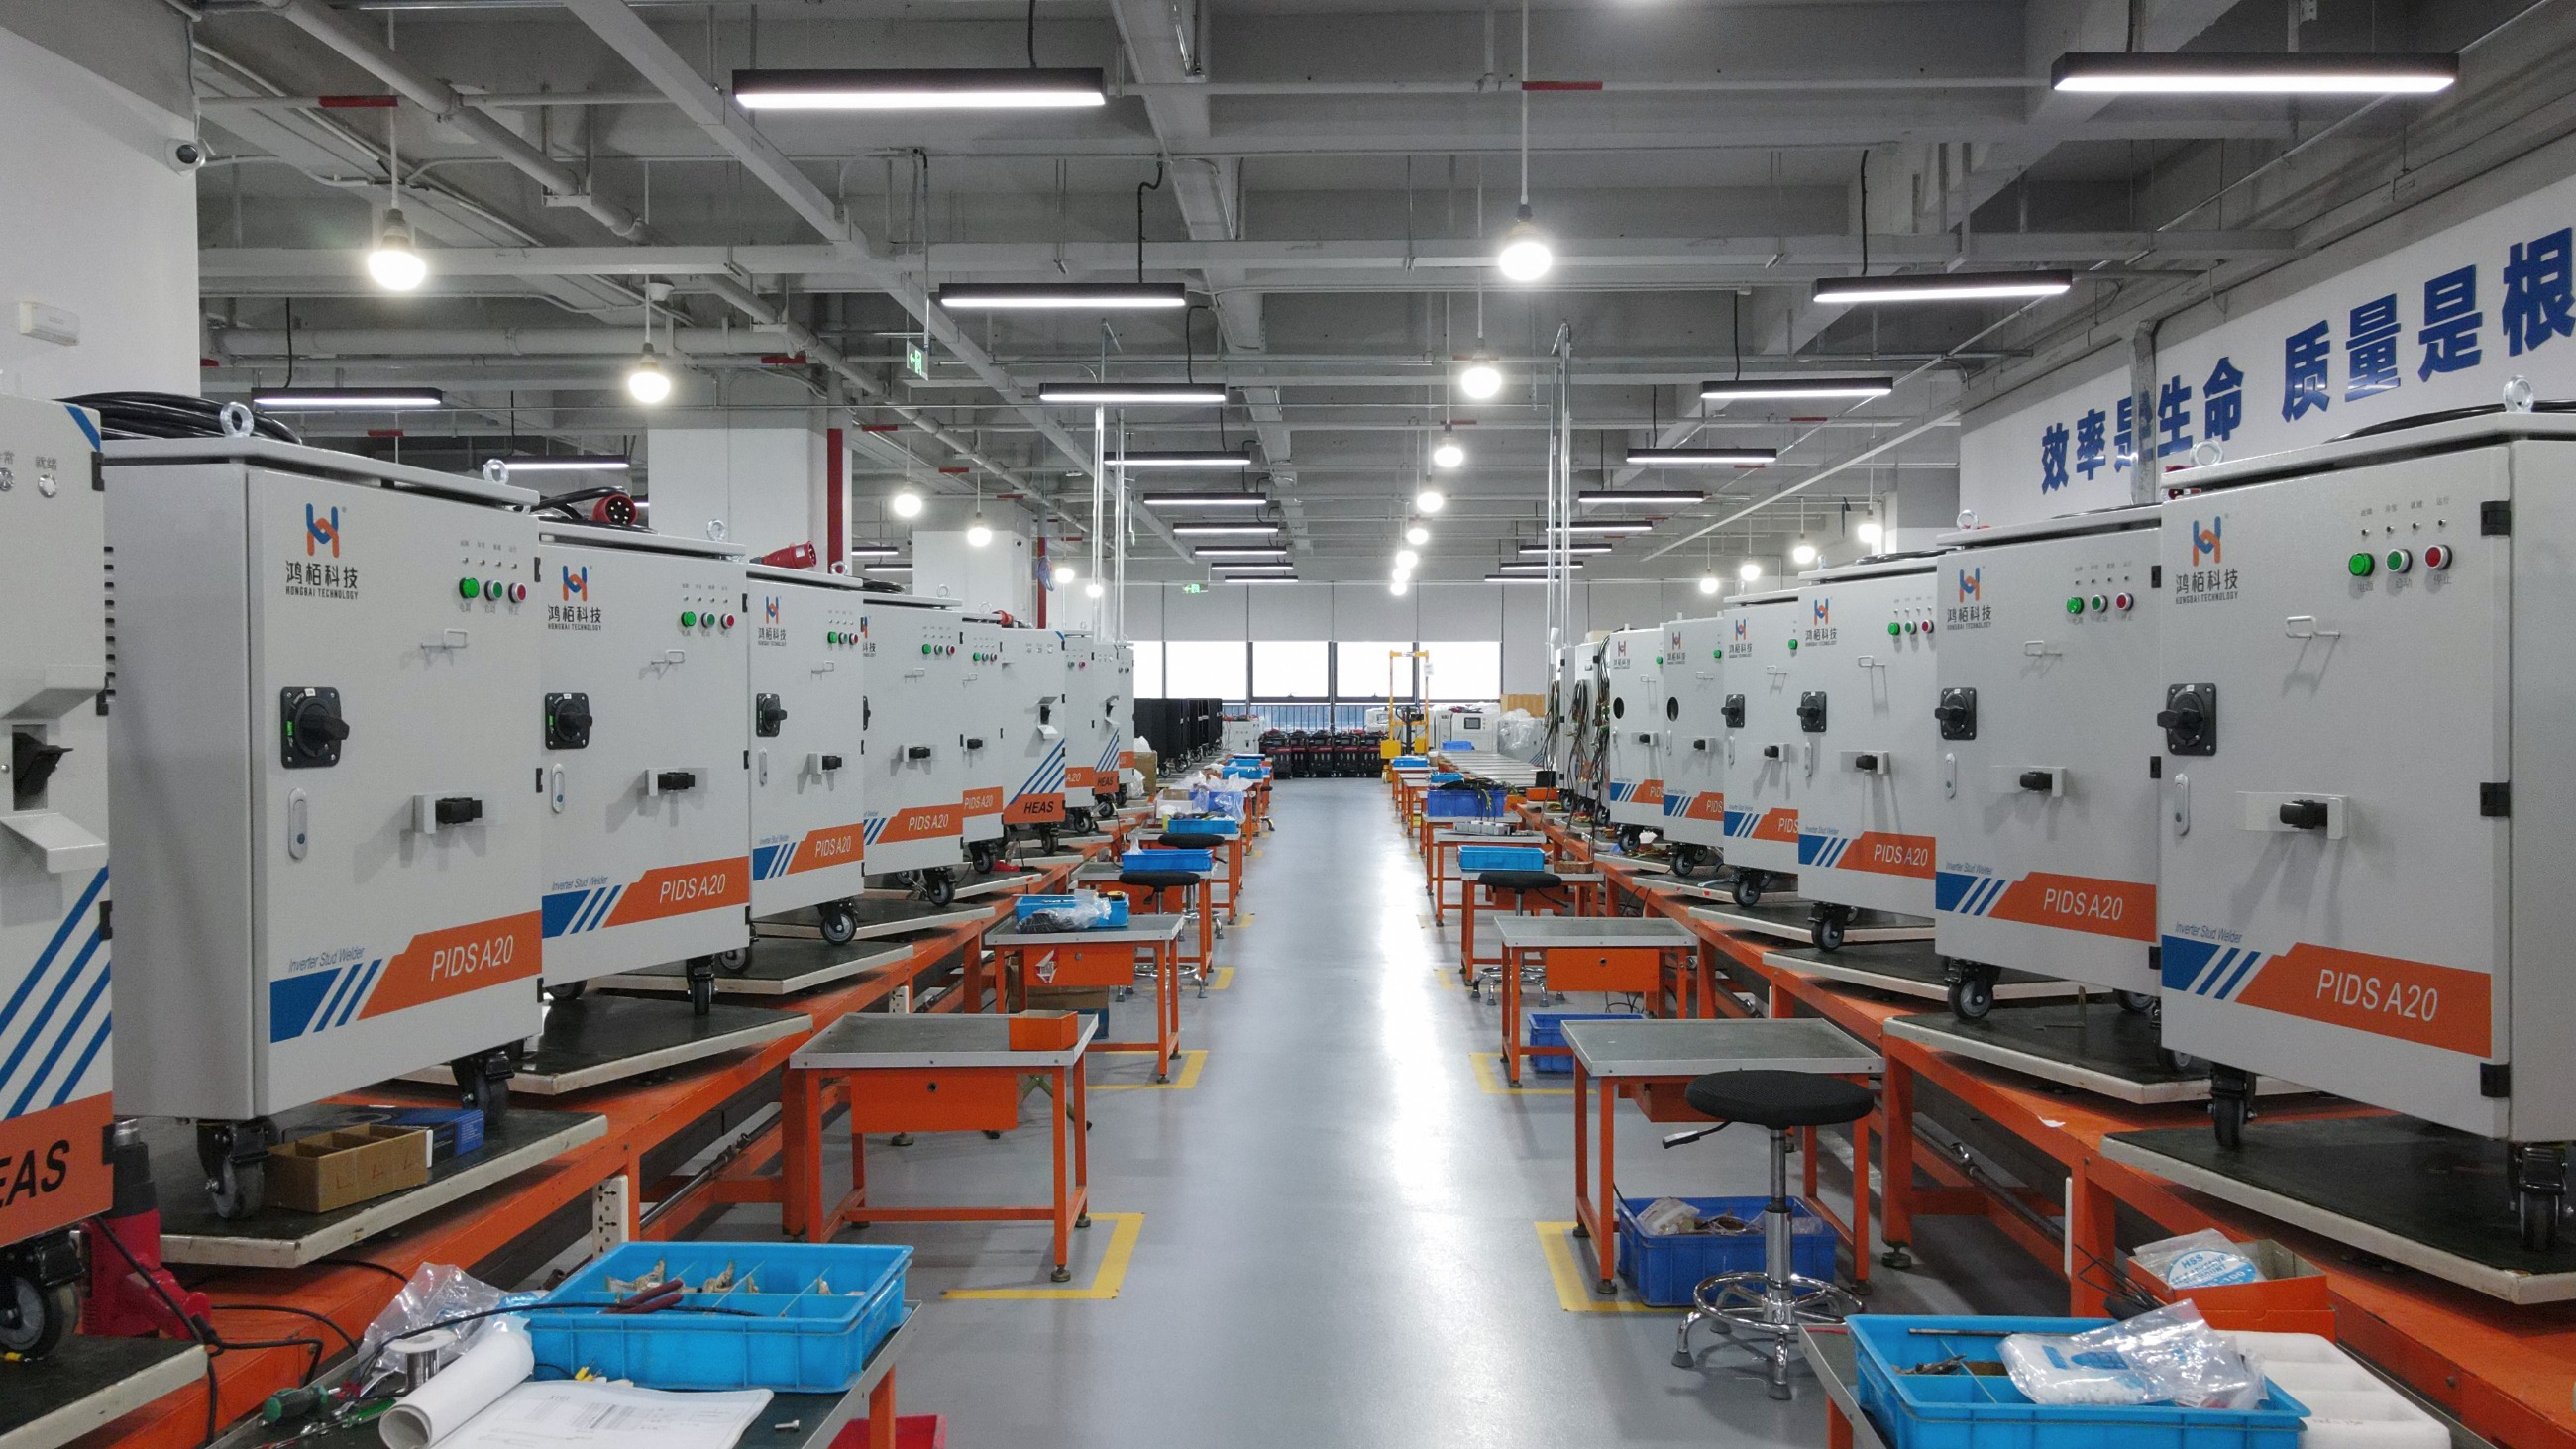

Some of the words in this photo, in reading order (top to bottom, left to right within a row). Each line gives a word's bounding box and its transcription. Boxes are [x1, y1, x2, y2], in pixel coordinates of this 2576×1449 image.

[2282, 227, 2576, 423] 质量是根
[285, 585, 315, 598] HONGBAI
[318, 587, 358, 600] TECHNOLOGY
[2176, 594, 2200, 604] HONGBAI
[2201, 591, 2238, 602] TECHNOLOGY
[1098, 776, 1113, 787] HEAS
[1649, 786, 1664, 799] PIDS
[1023, 800, 1054, 814] HEAS
[1706, 799, 1723, 813] PIDS
[908, 815, 930, 831] PIDS
[932, 813, 949, 829] A20
[1777, 817, 1798, 833] PIDS
[814, 840, 836, 857] PIDS
[837, 835, 852, 853] A20
[1874, 844, 1903, 864] PIDS
[1904, 847, 1928, 867] A20
[660, 879, 697, 903] PIDS
[698, 873, 726, 897] A20
[2044, 888, 2087, 916] PIDS
[2087, 894, 2123, 921] A20
[2175, 921, 2200, 937] Inverter
[2201, 924, 2217, 940] Stud
[2217, 928, 2243, 944] Welder
[288, 956, 319, 973] Inverter
[320, 952, 338, 967] Stud
[339, 946, 365, 963] Welder
[430, 942, 479, 982] PIDS
[480, 935, 513, 970] A20
[2316, 968, 2380, 1010] PIDS
[2383, 982, 2438, 1022] A20
[2181, 1253, 2204, 1268] HSS
